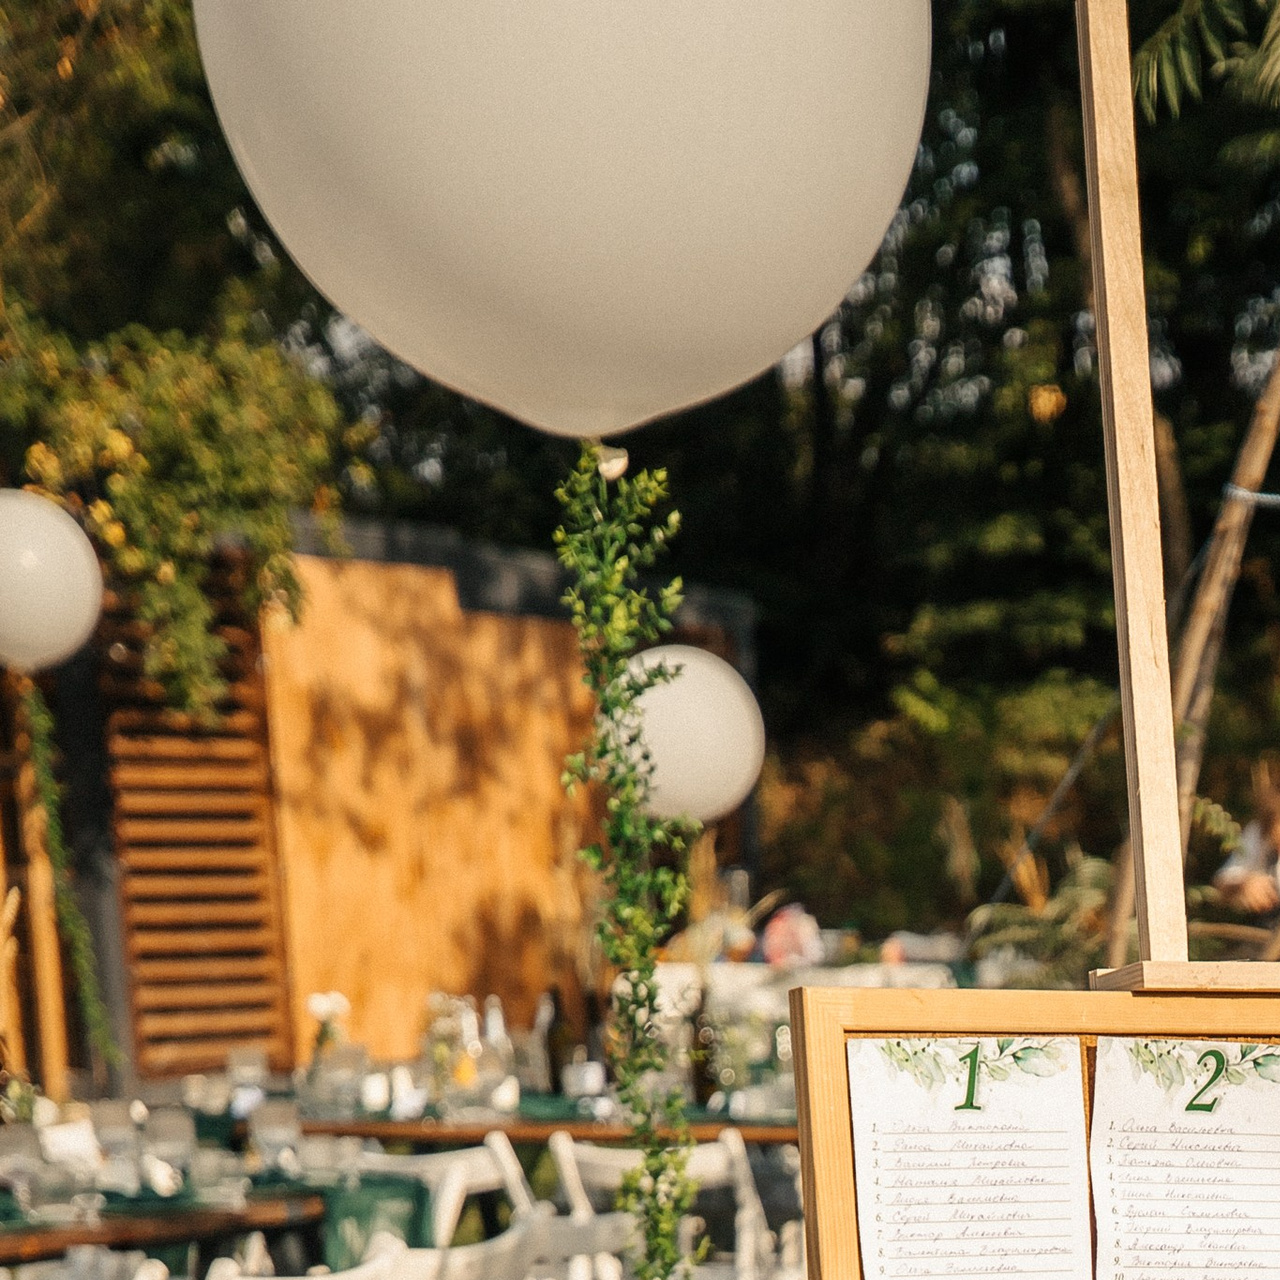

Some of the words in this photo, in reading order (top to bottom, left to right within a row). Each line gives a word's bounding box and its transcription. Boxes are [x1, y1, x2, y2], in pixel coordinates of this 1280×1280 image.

[954, 1045, 981, 1111] 1
[1185, 1049, 1226, 1113] 2
[1109, 1121, 1117, 1130] 1.
[1107, 1138, 1115, 1147] 2.
[1107, 1155, 1115, 1164] 3.
[1109, 1173, 1117, 1182] 4.
[1111, 1188, 1119, 1197] 5.
[1112, 1206, 1120, 1215] 6.
[1114, 1222, 1122, 1231] 7.
[1115, 1239, 1123, 1248] 8.
[1114, 1257, 1122, 1266] 9.
